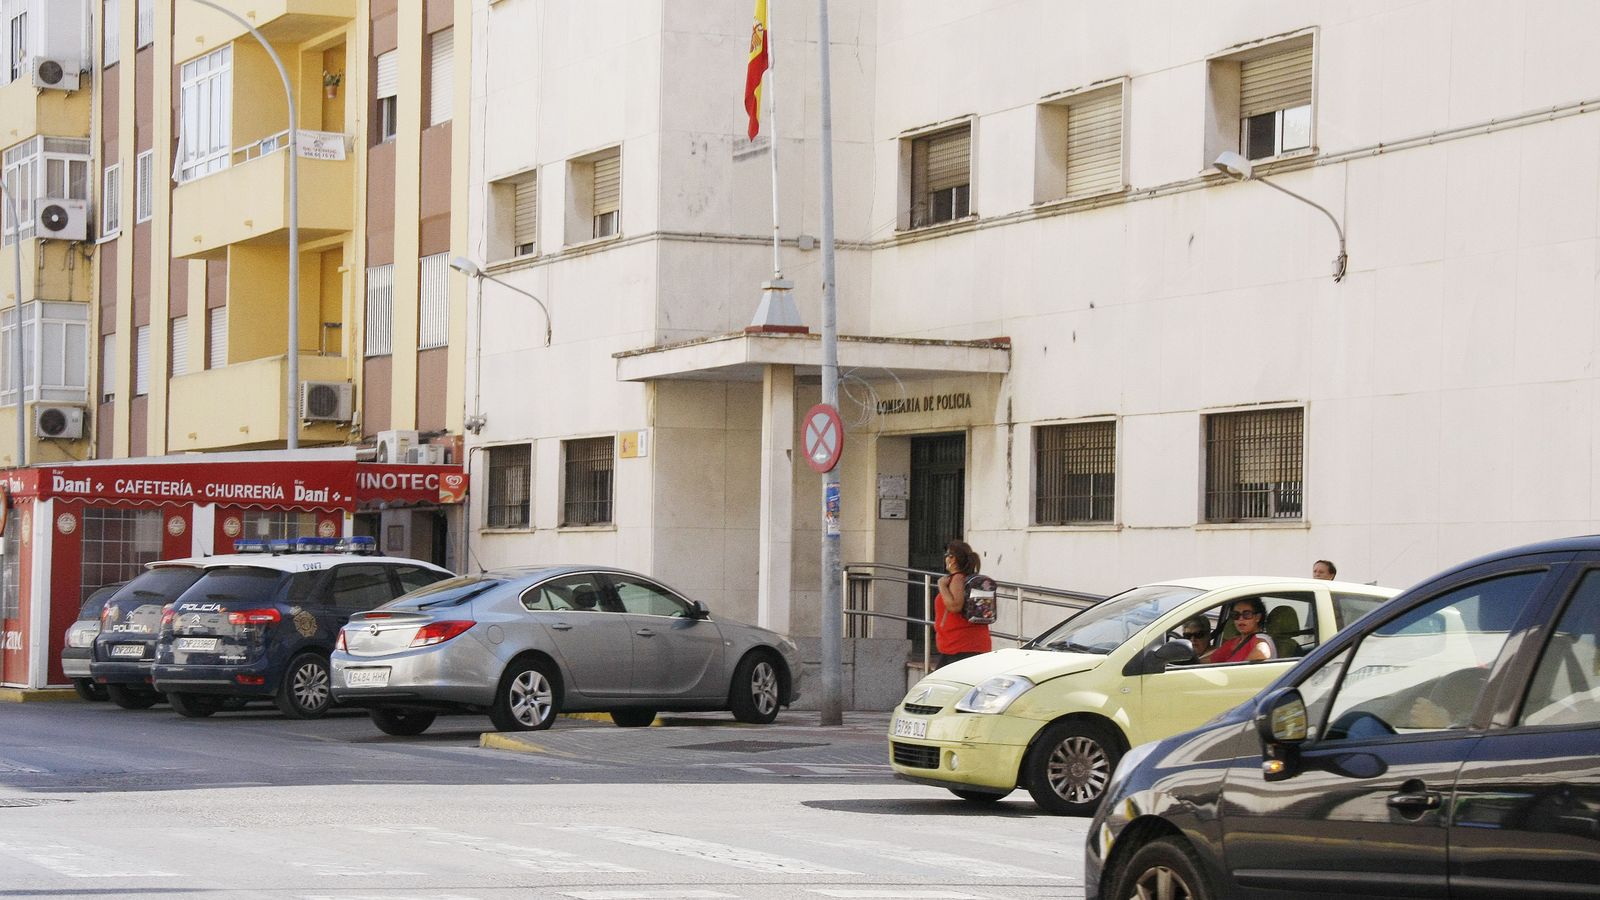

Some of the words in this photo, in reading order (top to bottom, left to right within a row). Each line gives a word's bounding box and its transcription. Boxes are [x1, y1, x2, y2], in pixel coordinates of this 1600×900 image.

[877, 398, 920, 415] COMISARIA
[924, 395, 934, 412] DE
[937, 393, 972, 410] POLICIA
[52, 475, 91, 493] Dani
[115, 479, 194, 497] CAFETERÍA
[205, 483, 284, 500] CHURRERÍA
[294, 485, 329, 503] Dani
[179, 602, 221, 611] POLICÍA
